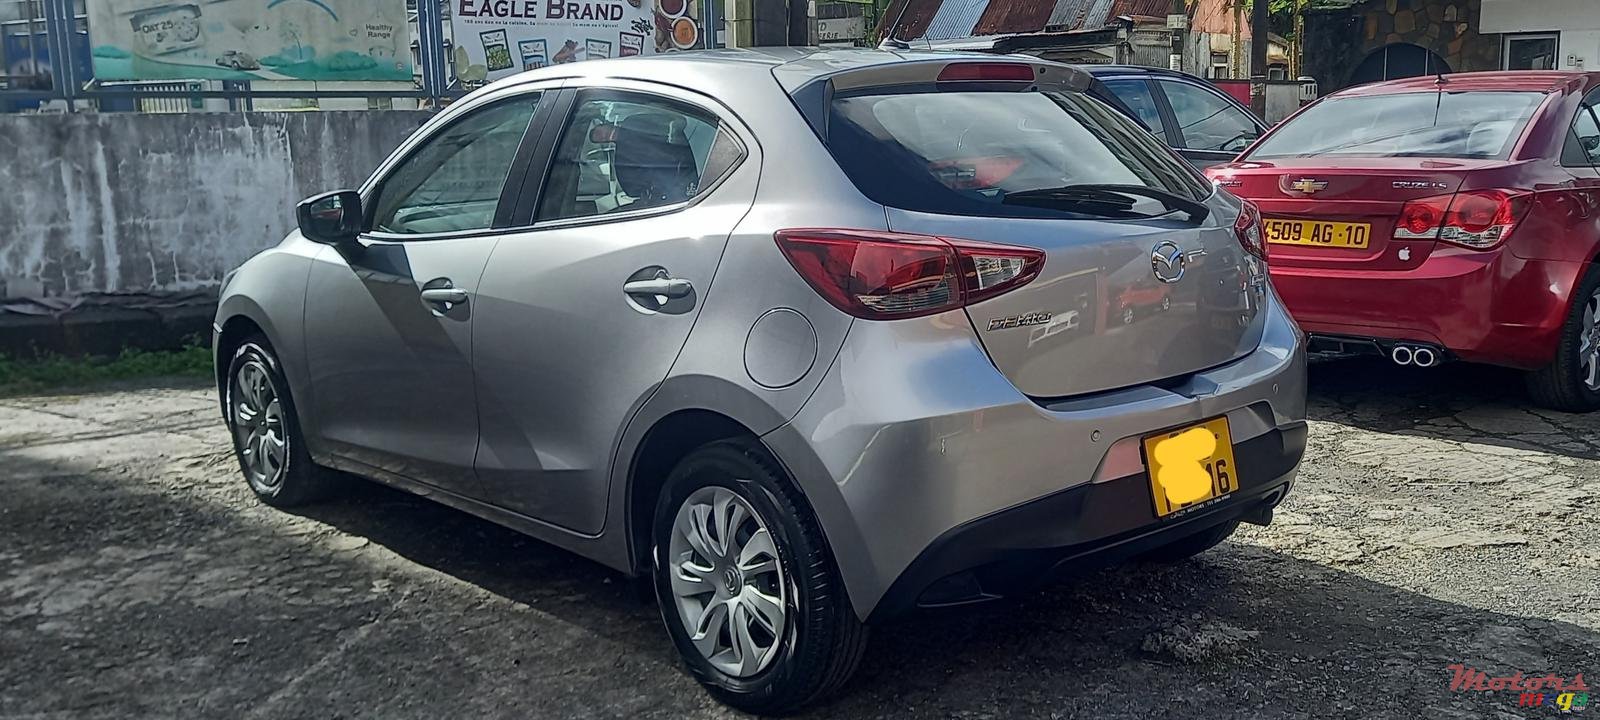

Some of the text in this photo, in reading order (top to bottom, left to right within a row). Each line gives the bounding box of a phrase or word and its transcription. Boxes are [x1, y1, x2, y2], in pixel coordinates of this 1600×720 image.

[458, 0, 624, 21] EAGLE BRAND
[365, 24, 393, 32] Healthy
[367, 31, 391, 39] Range
[1310, 223, 1334, 243] AG
